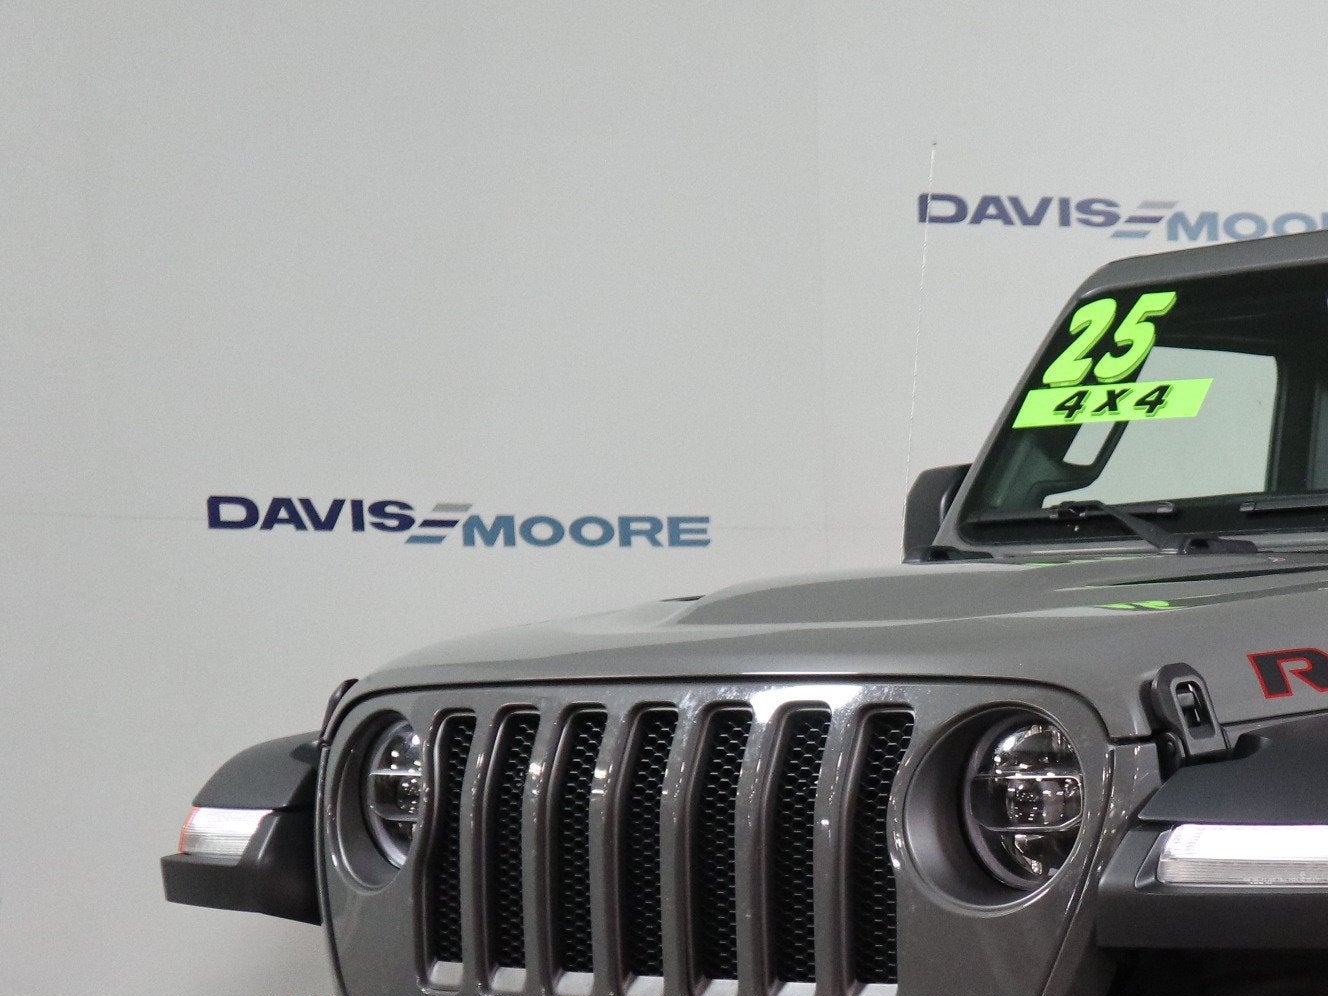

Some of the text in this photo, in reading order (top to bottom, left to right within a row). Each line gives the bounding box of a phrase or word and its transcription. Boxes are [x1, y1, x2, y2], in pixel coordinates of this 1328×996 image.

[918, 193, 1121, 227] DAVIS
[1042, 291, 1178, 387] 25
[206, 495, 711, 548] DAVIS MOORE
